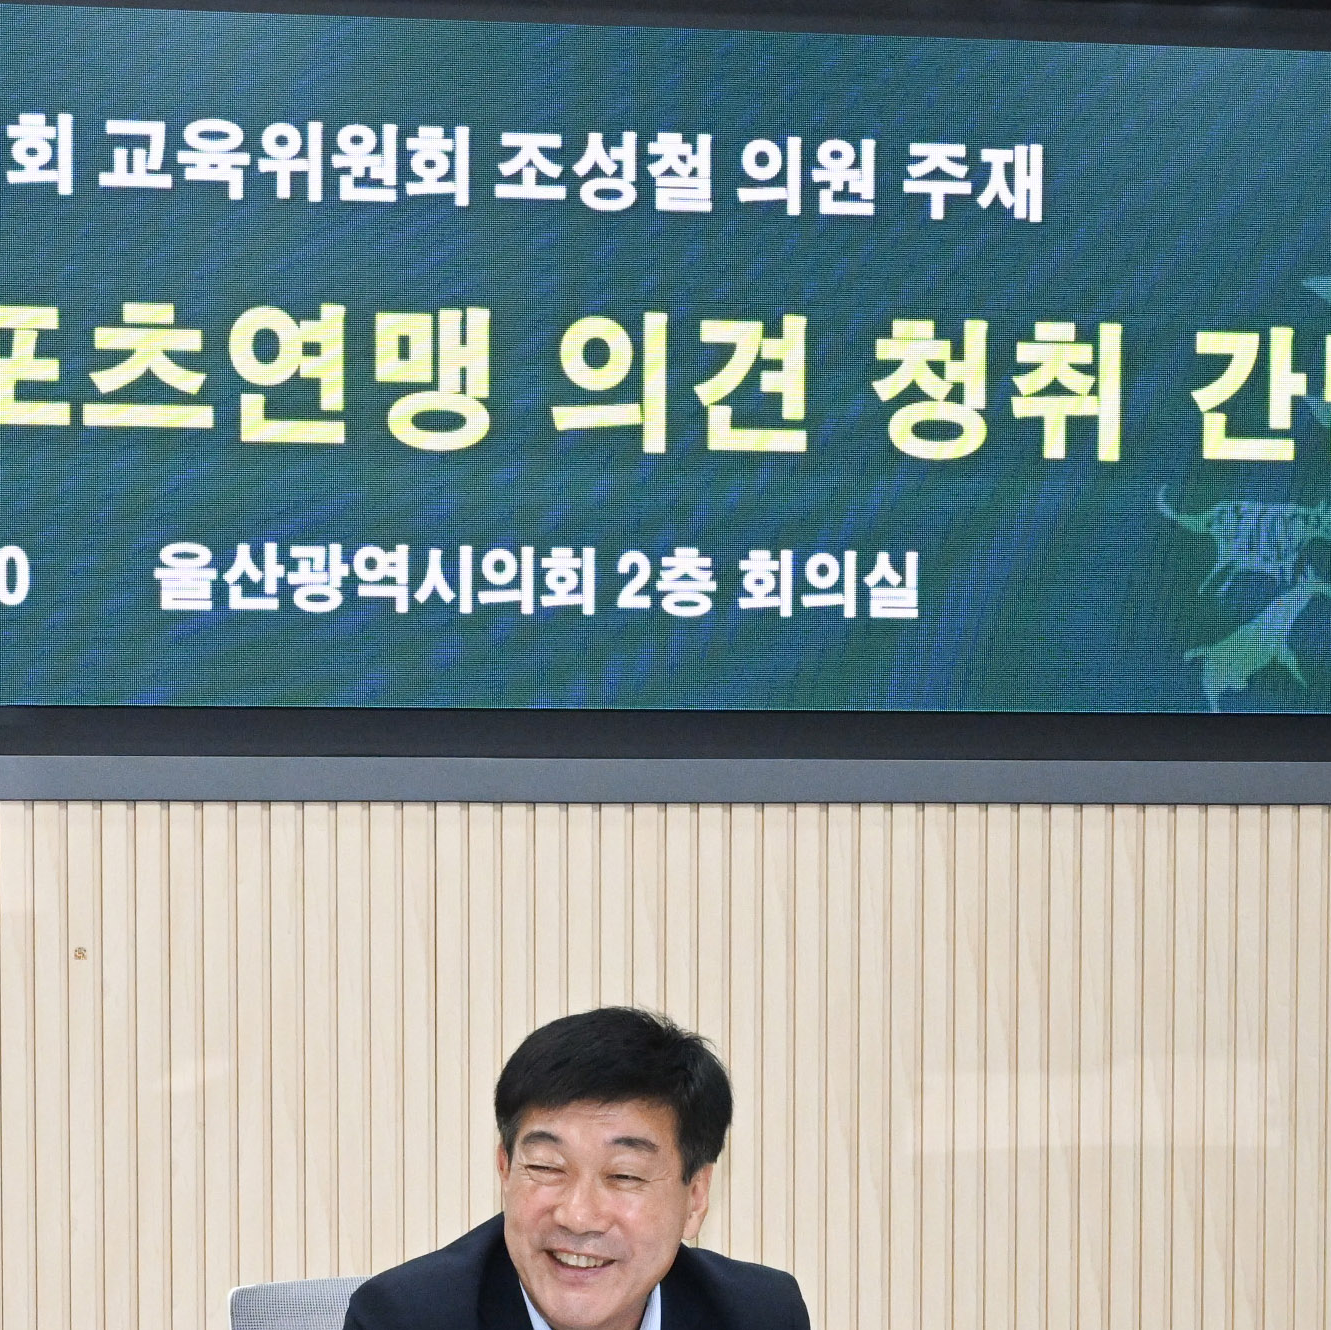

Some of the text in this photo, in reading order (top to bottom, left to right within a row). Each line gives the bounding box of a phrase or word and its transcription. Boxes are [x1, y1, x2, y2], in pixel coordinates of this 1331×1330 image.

[97, 113, 472, 208] 교육위원회
[493, 130, 713, 213] 조성철
[736, 135, 878, 218] 의원
[902, 142, 1046, 223] 주재
[550, 311, 808, 455] 의견
[871, 318, 1123, 463] 청취
[152, 541, 596, 616] 울산광역시의회
[616, 546, 718, 618] 2층
[737, 548, 920, 620] 회의실
